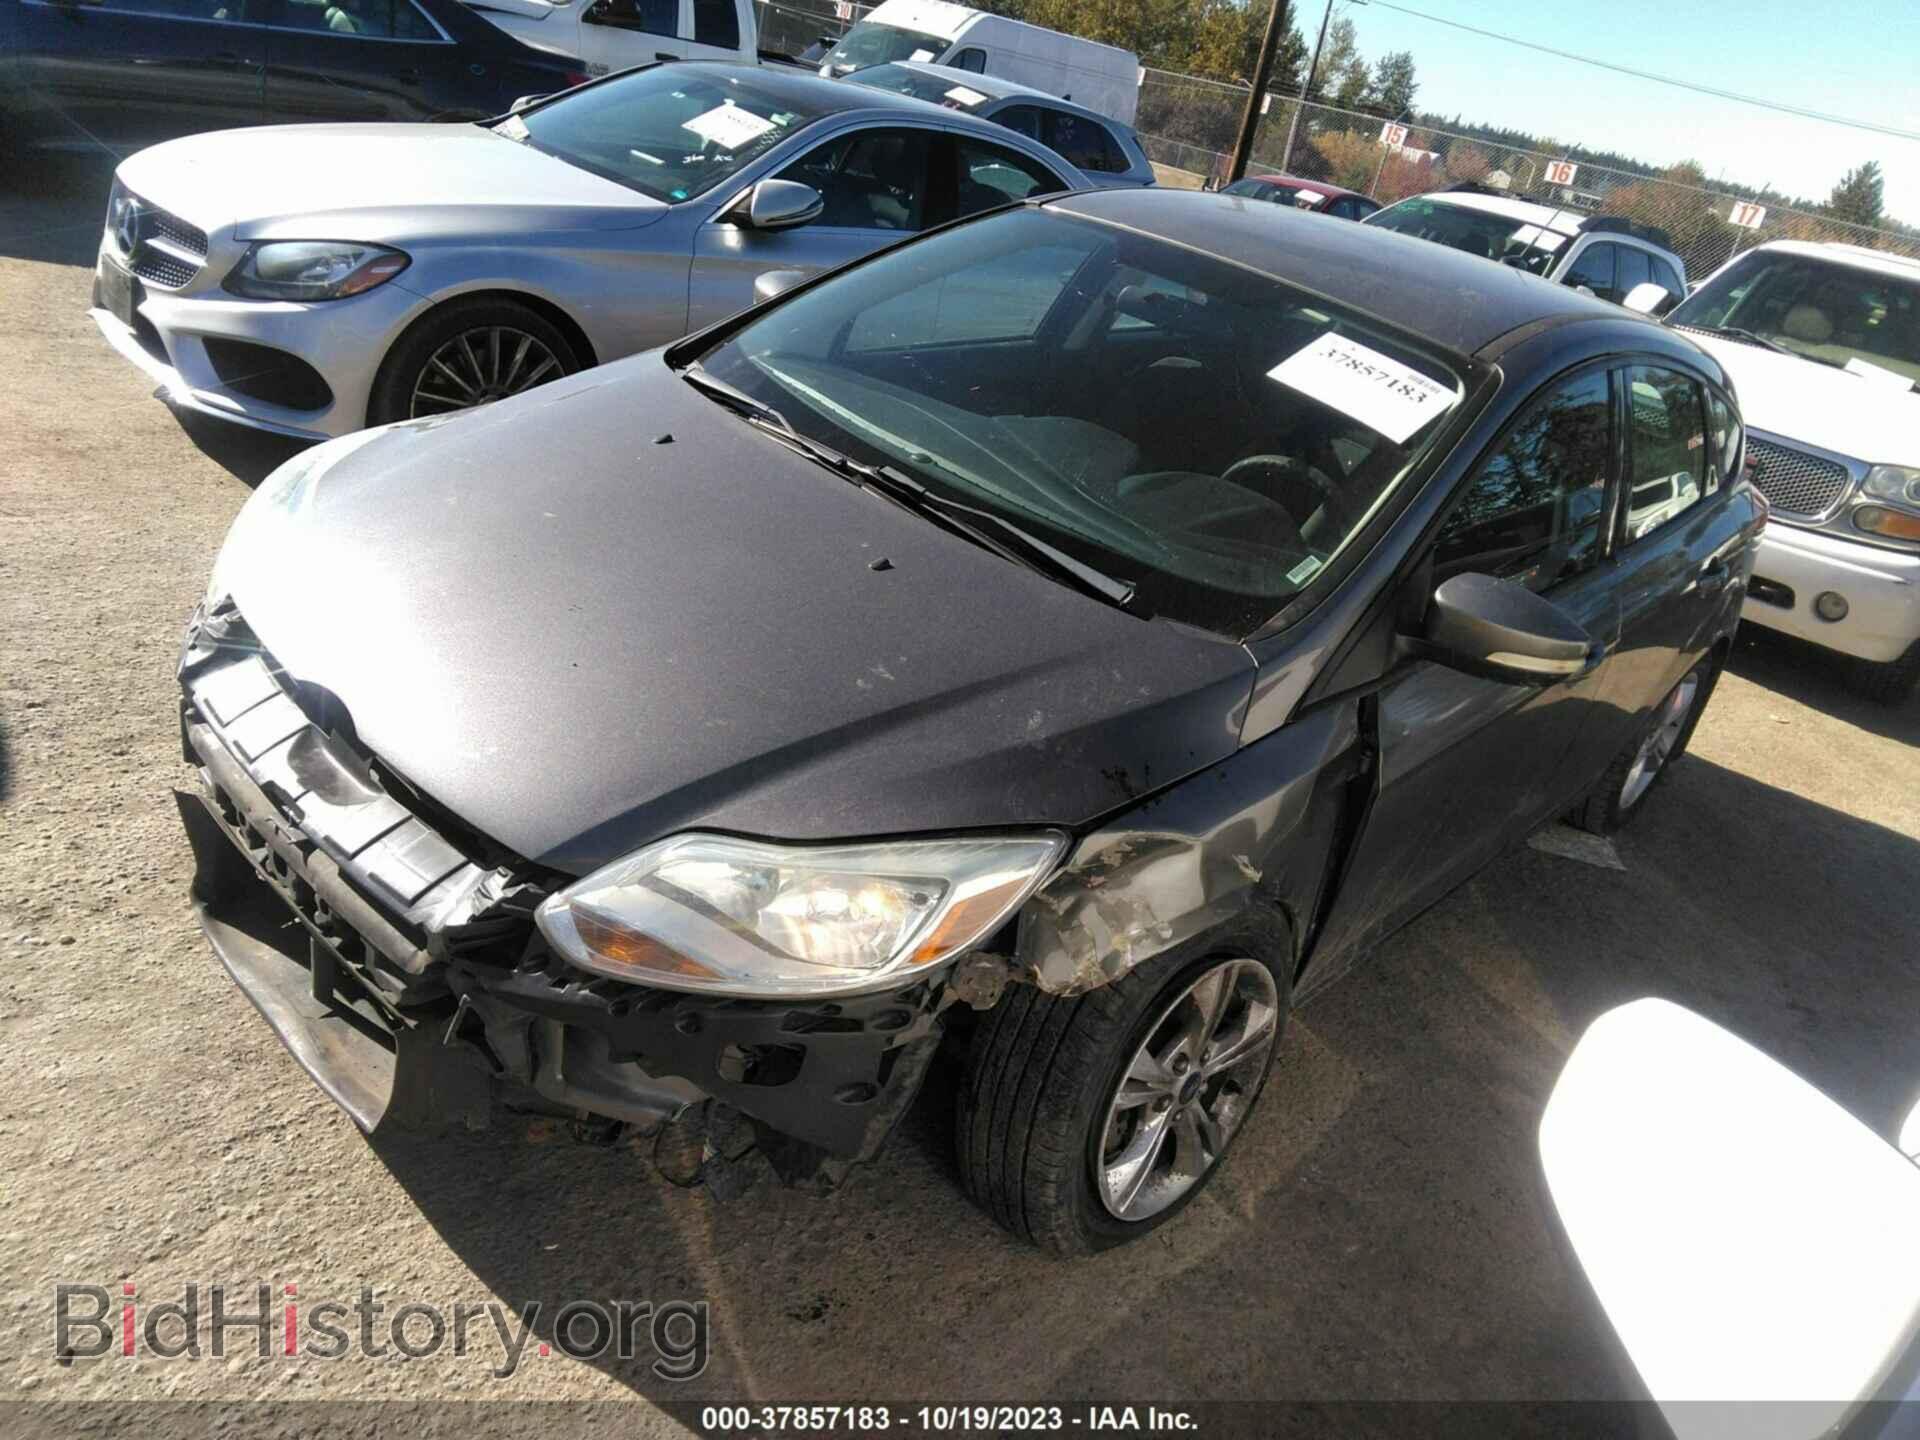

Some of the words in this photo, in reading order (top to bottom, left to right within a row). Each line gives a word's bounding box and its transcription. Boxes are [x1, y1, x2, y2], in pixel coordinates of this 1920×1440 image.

[1385, 126, 1404, 144] 15
[1552, 163, 1572, 182] 16
[1738, 203, 1760, 225] 17
[1319, 347, 1428, 403] 37857183
